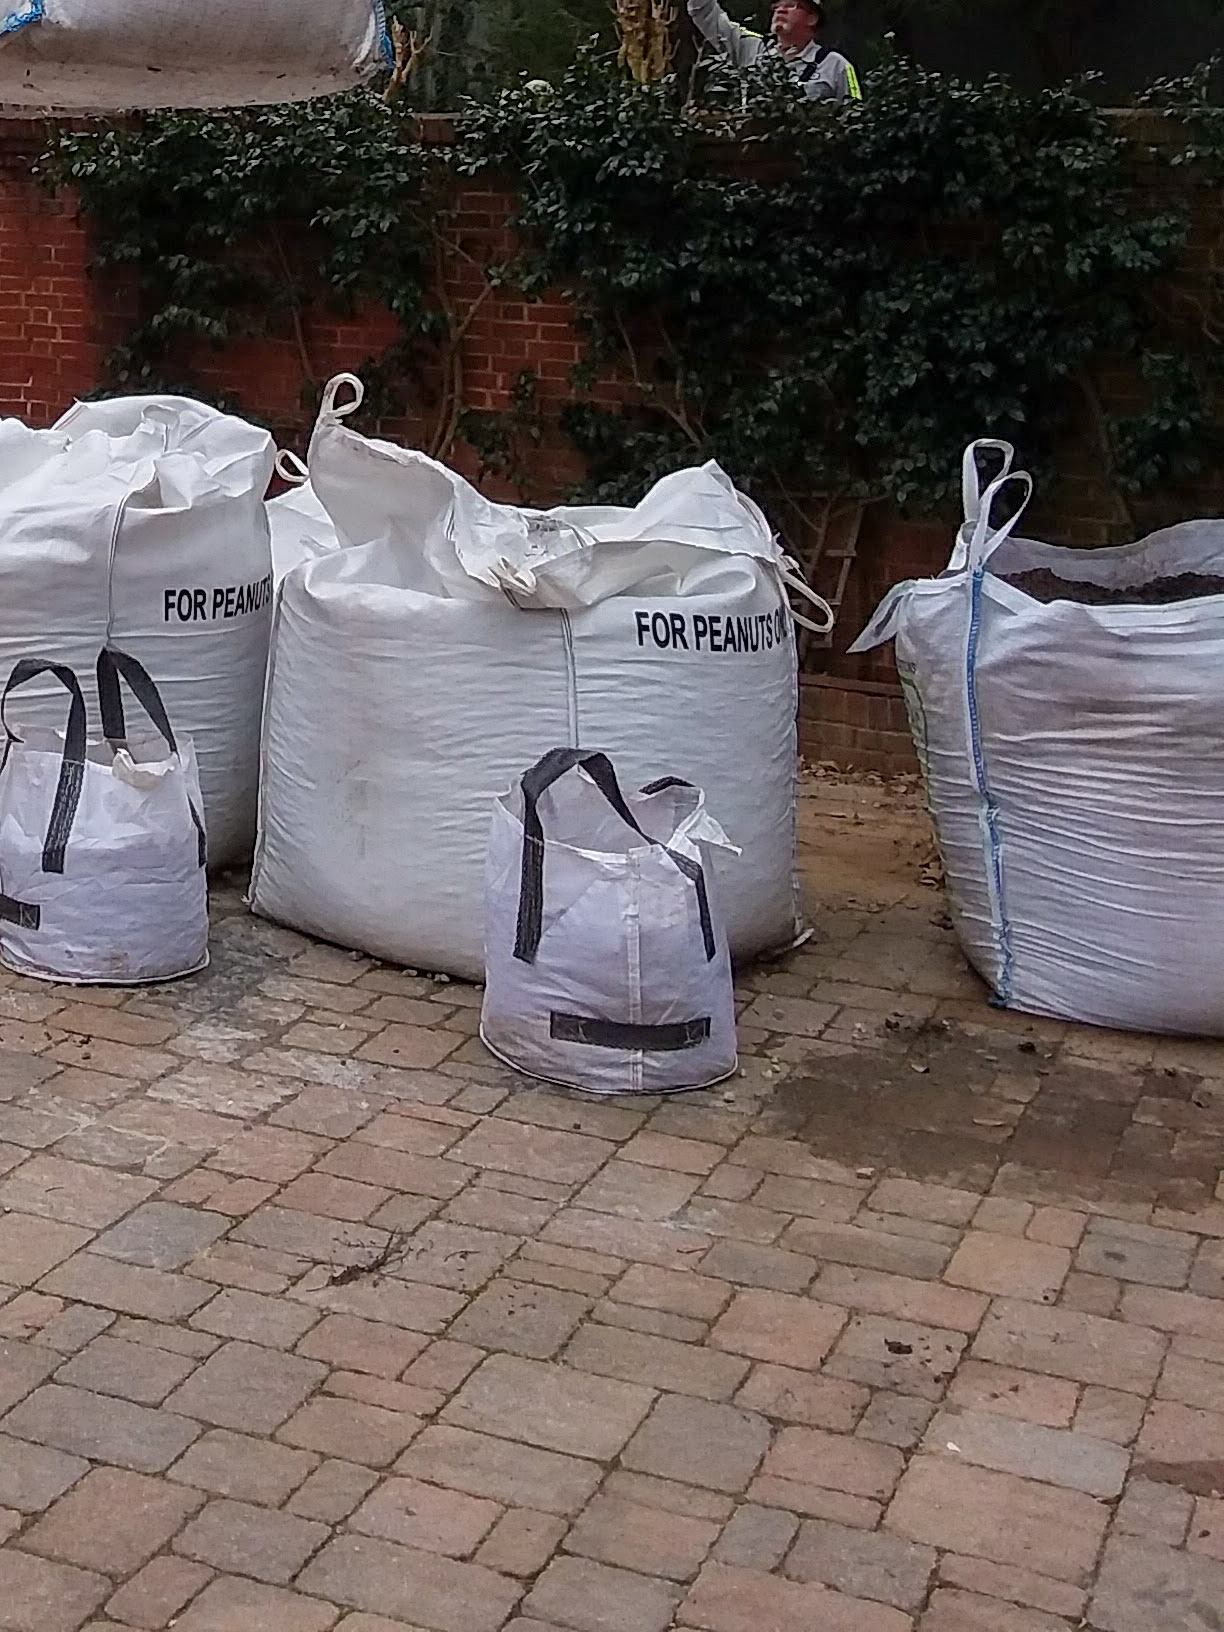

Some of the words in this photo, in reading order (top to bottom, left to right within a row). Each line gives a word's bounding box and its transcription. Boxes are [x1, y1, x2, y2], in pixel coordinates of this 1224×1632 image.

[164, 589, 207, 622] FOR
[212, 574, 271, 620] PEANUTS
[634, 610, 689, 650] FOR
[692, 612, 773, 653] PEANUTS
